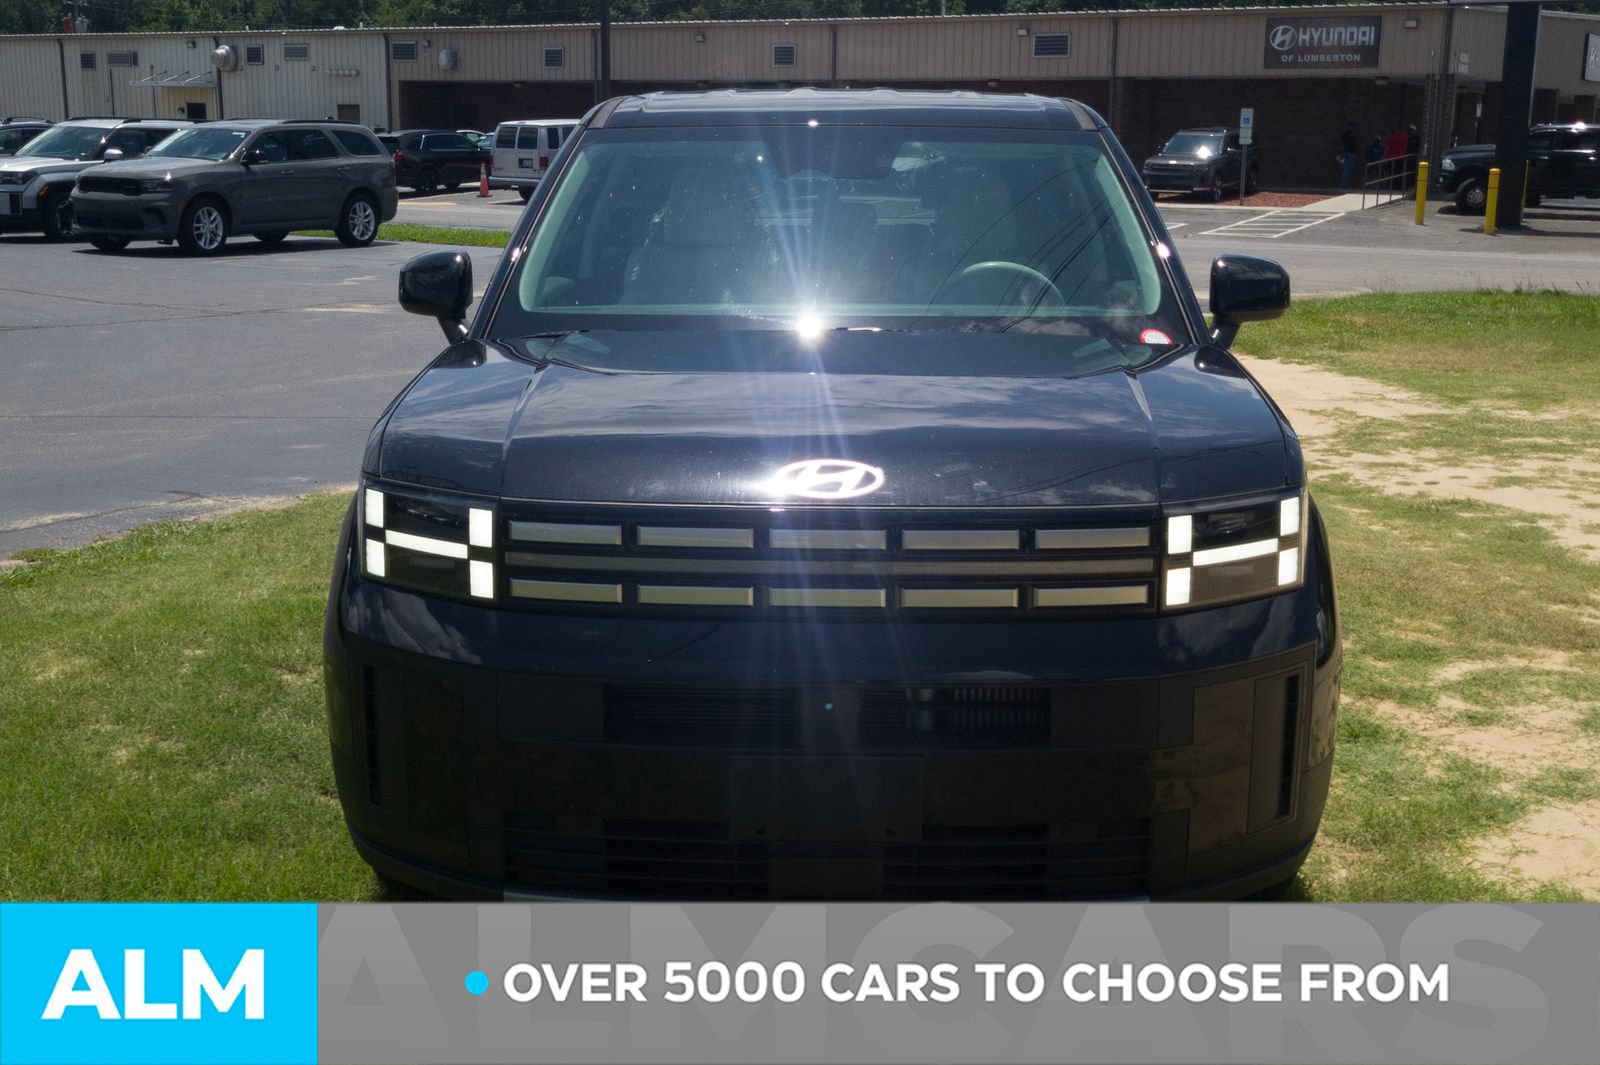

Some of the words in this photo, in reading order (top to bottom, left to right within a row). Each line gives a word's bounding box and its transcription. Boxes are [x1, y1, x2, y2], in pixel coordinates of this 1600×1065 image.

[1298, 26, 1376, 47] HYUNDAI
[1281, 54, 1296, 63] OF
[1298, 53, 1361, 63] LUMBERTON
